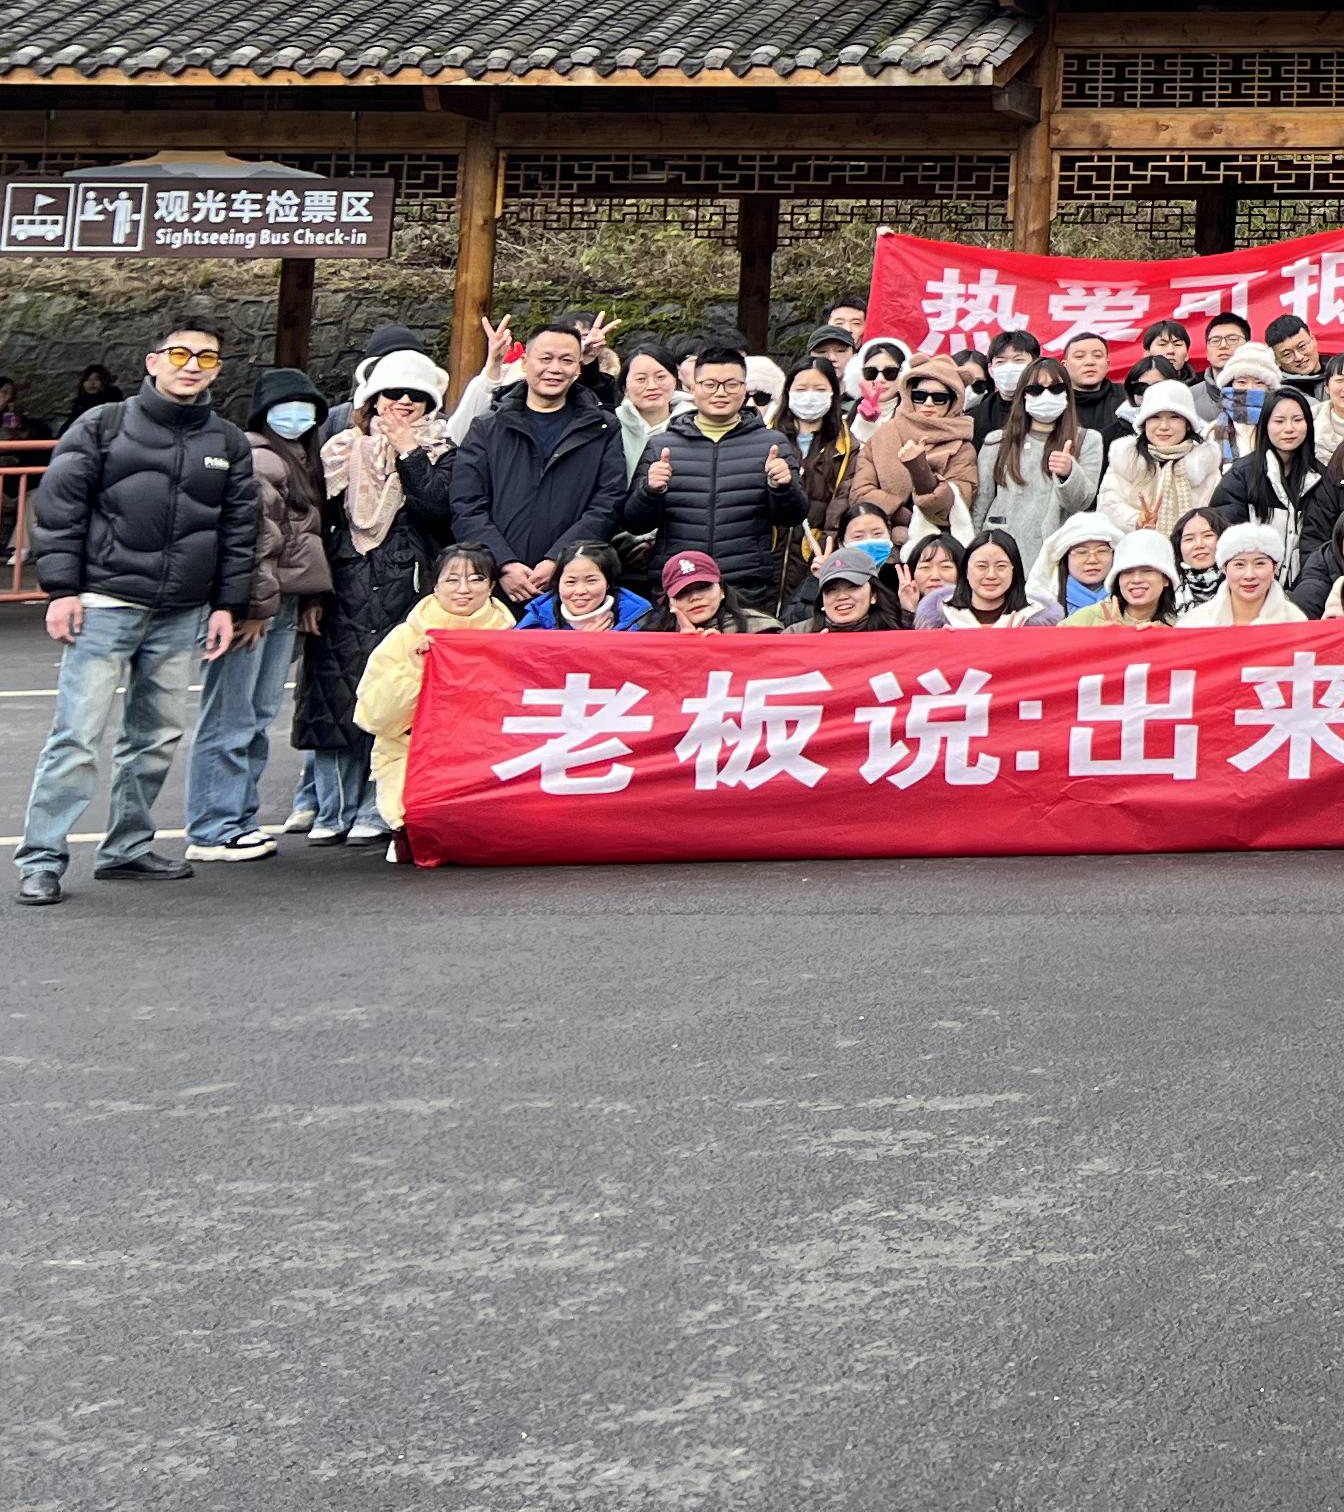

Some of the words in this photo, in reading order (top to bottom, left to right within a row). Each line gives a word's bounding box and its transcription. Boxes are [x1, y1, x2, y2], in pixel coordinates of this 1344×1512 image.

[153, 189, 375, 225] 观光车检票区
[155, 226, 257, 249] Sightseeing
[259, 227, 290, 246] Bus
[292, 227, 368, 246] Check-in
